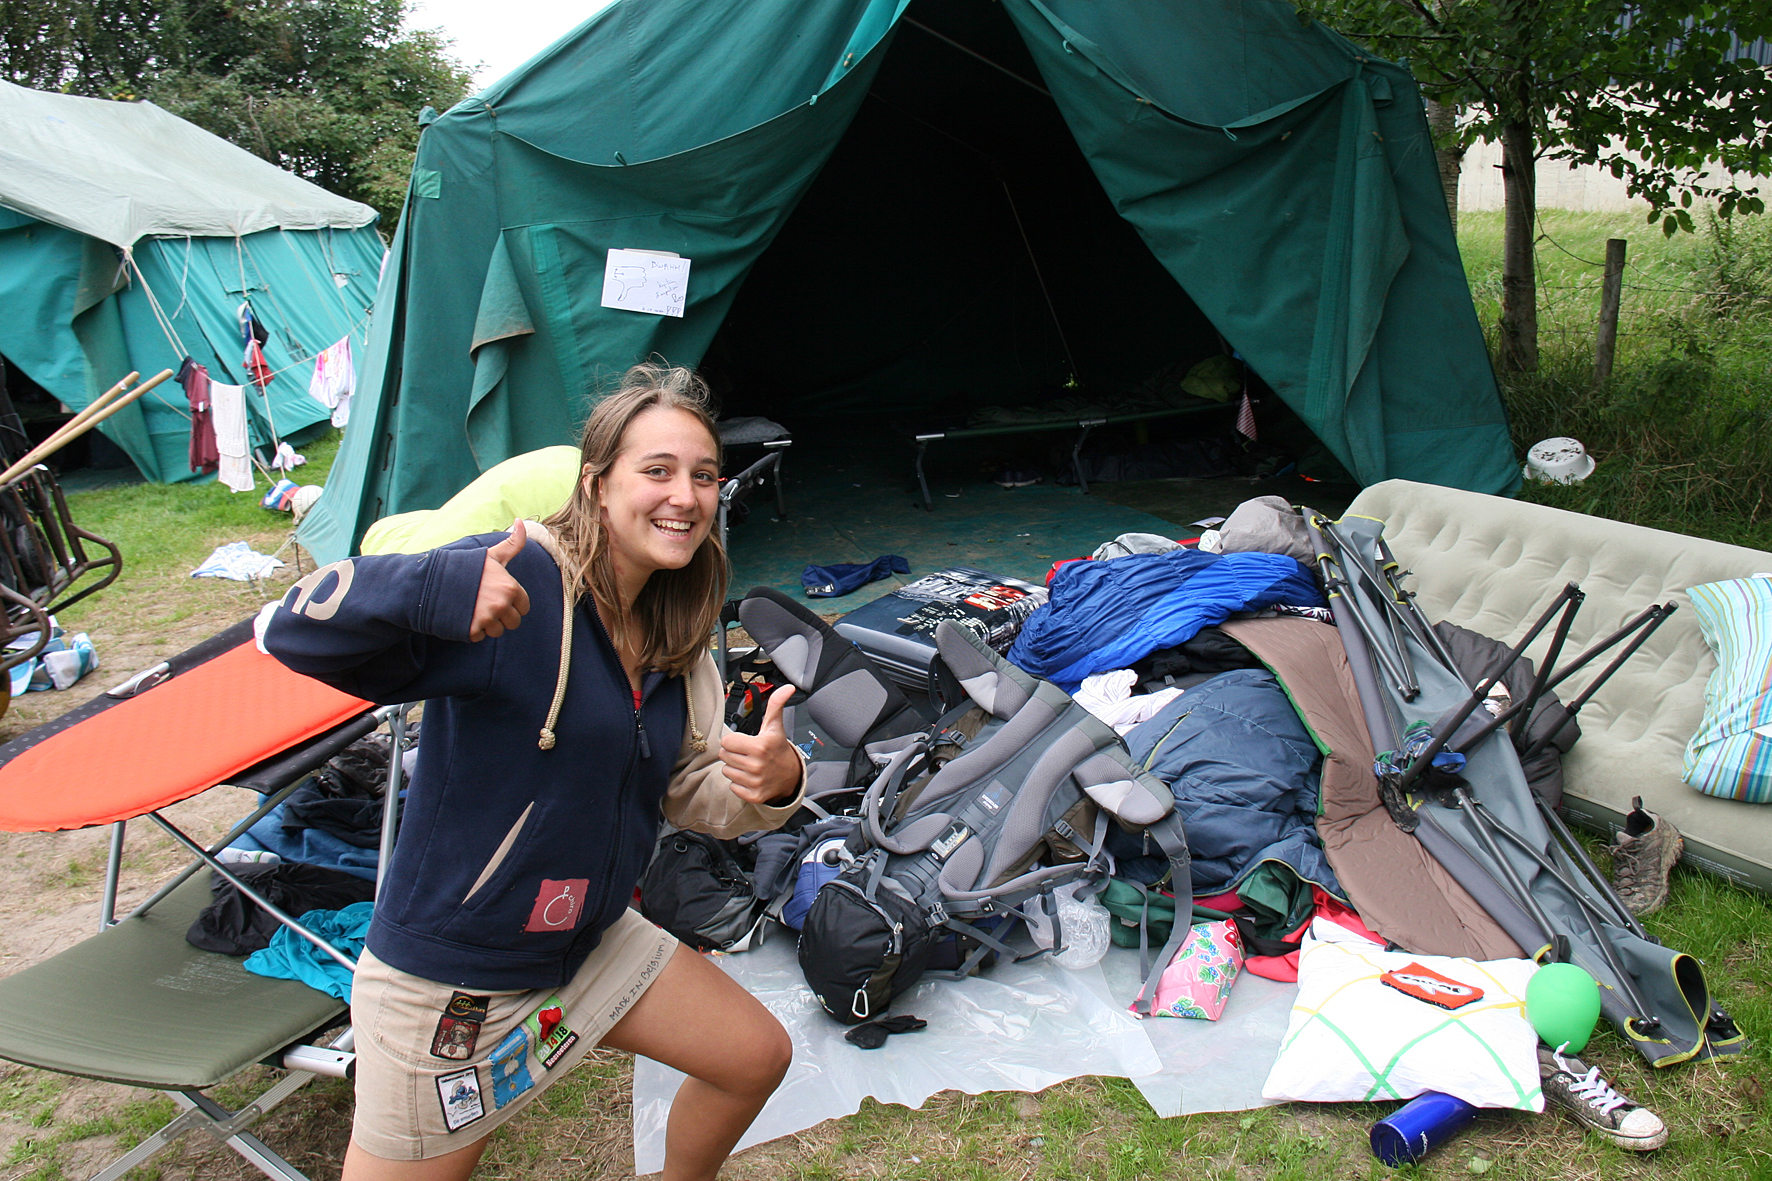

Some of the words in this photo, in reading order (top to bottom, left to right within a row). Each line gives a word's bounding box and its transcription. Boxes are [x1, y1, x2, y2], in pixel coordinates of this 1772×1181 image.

[609, 995, 630, 1021] MADE
[629, 980, 643, 997] IN
[641, 944, 665, 980] Belgium
[545, 1035, 576, 1067] Neeroeteren
